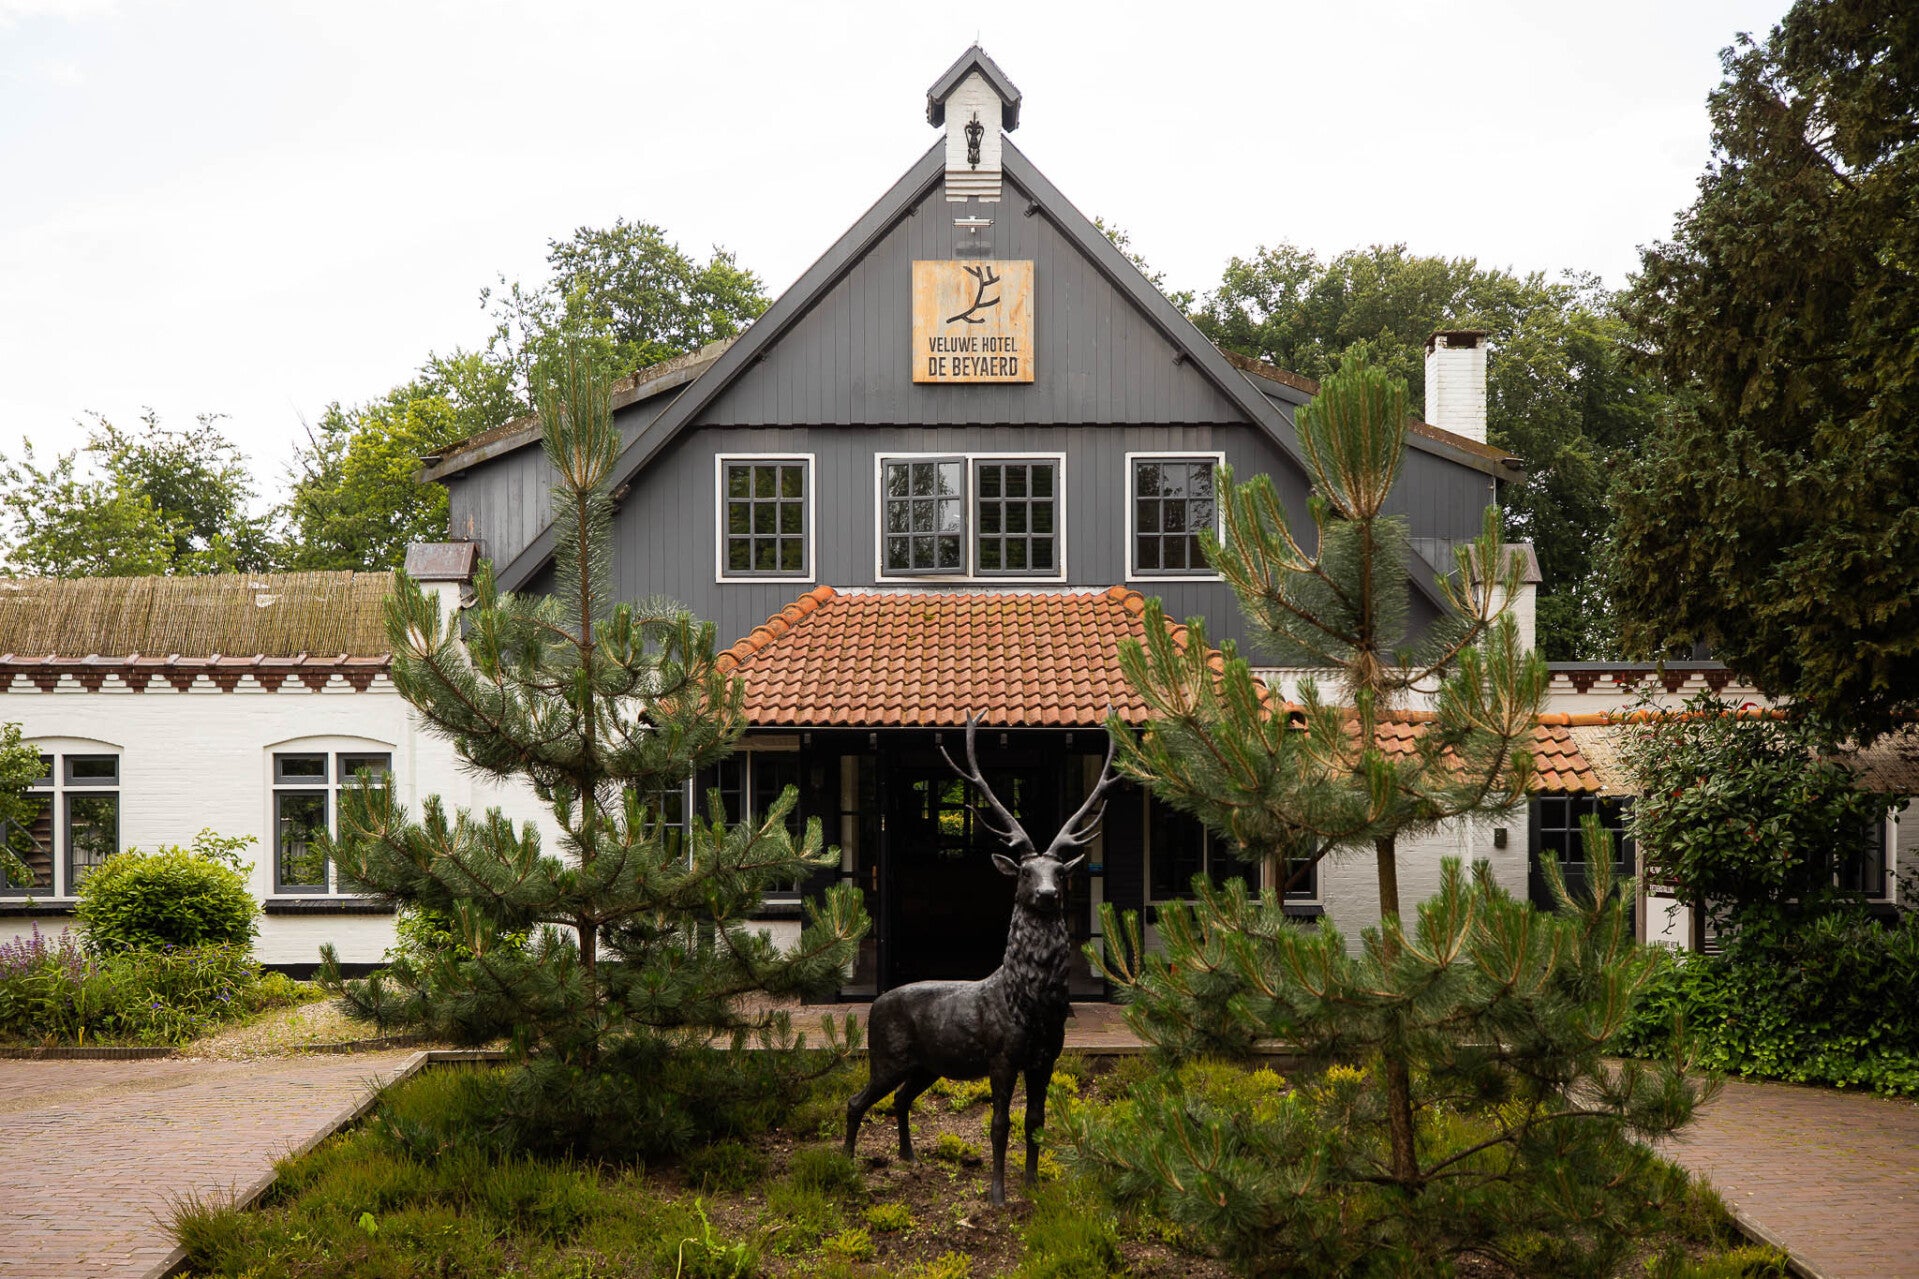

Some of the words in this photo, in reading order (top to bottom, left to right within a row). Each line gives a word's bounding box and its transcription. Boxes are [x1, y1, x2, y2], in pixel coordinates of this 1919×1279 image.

[929, 337, 978, 352] VELUWE
[982, 337, 1018, 352] HOTEL
[928, 357, 947, 376] DE
[952, 357, 1018, 376] BEYAERD
